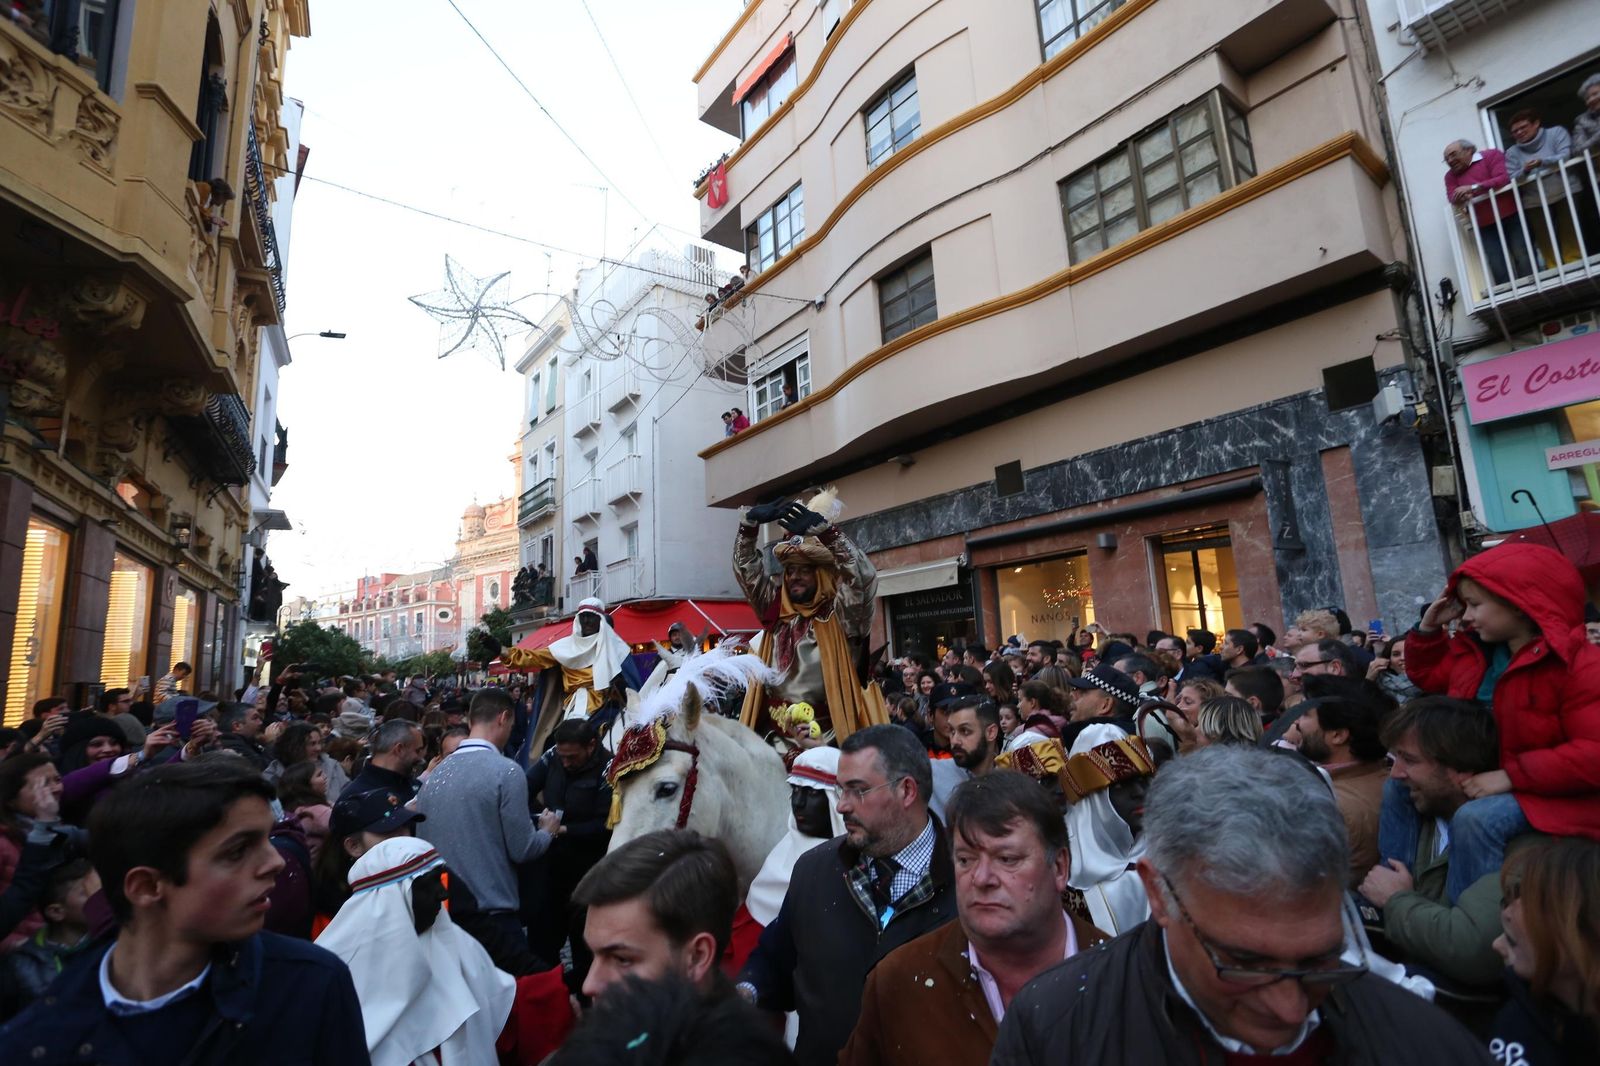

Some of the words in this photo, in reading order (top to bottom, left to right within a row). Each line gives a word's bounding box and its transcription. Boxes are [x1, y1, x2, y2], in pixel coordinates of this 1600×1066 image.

[1476, 374, 1511, 403] El
[1550, 447, 1600, 463] ARREGL
[915, 590, 963, 606] SALVADOR
[1031, 610, 1071, 624] NANOS
